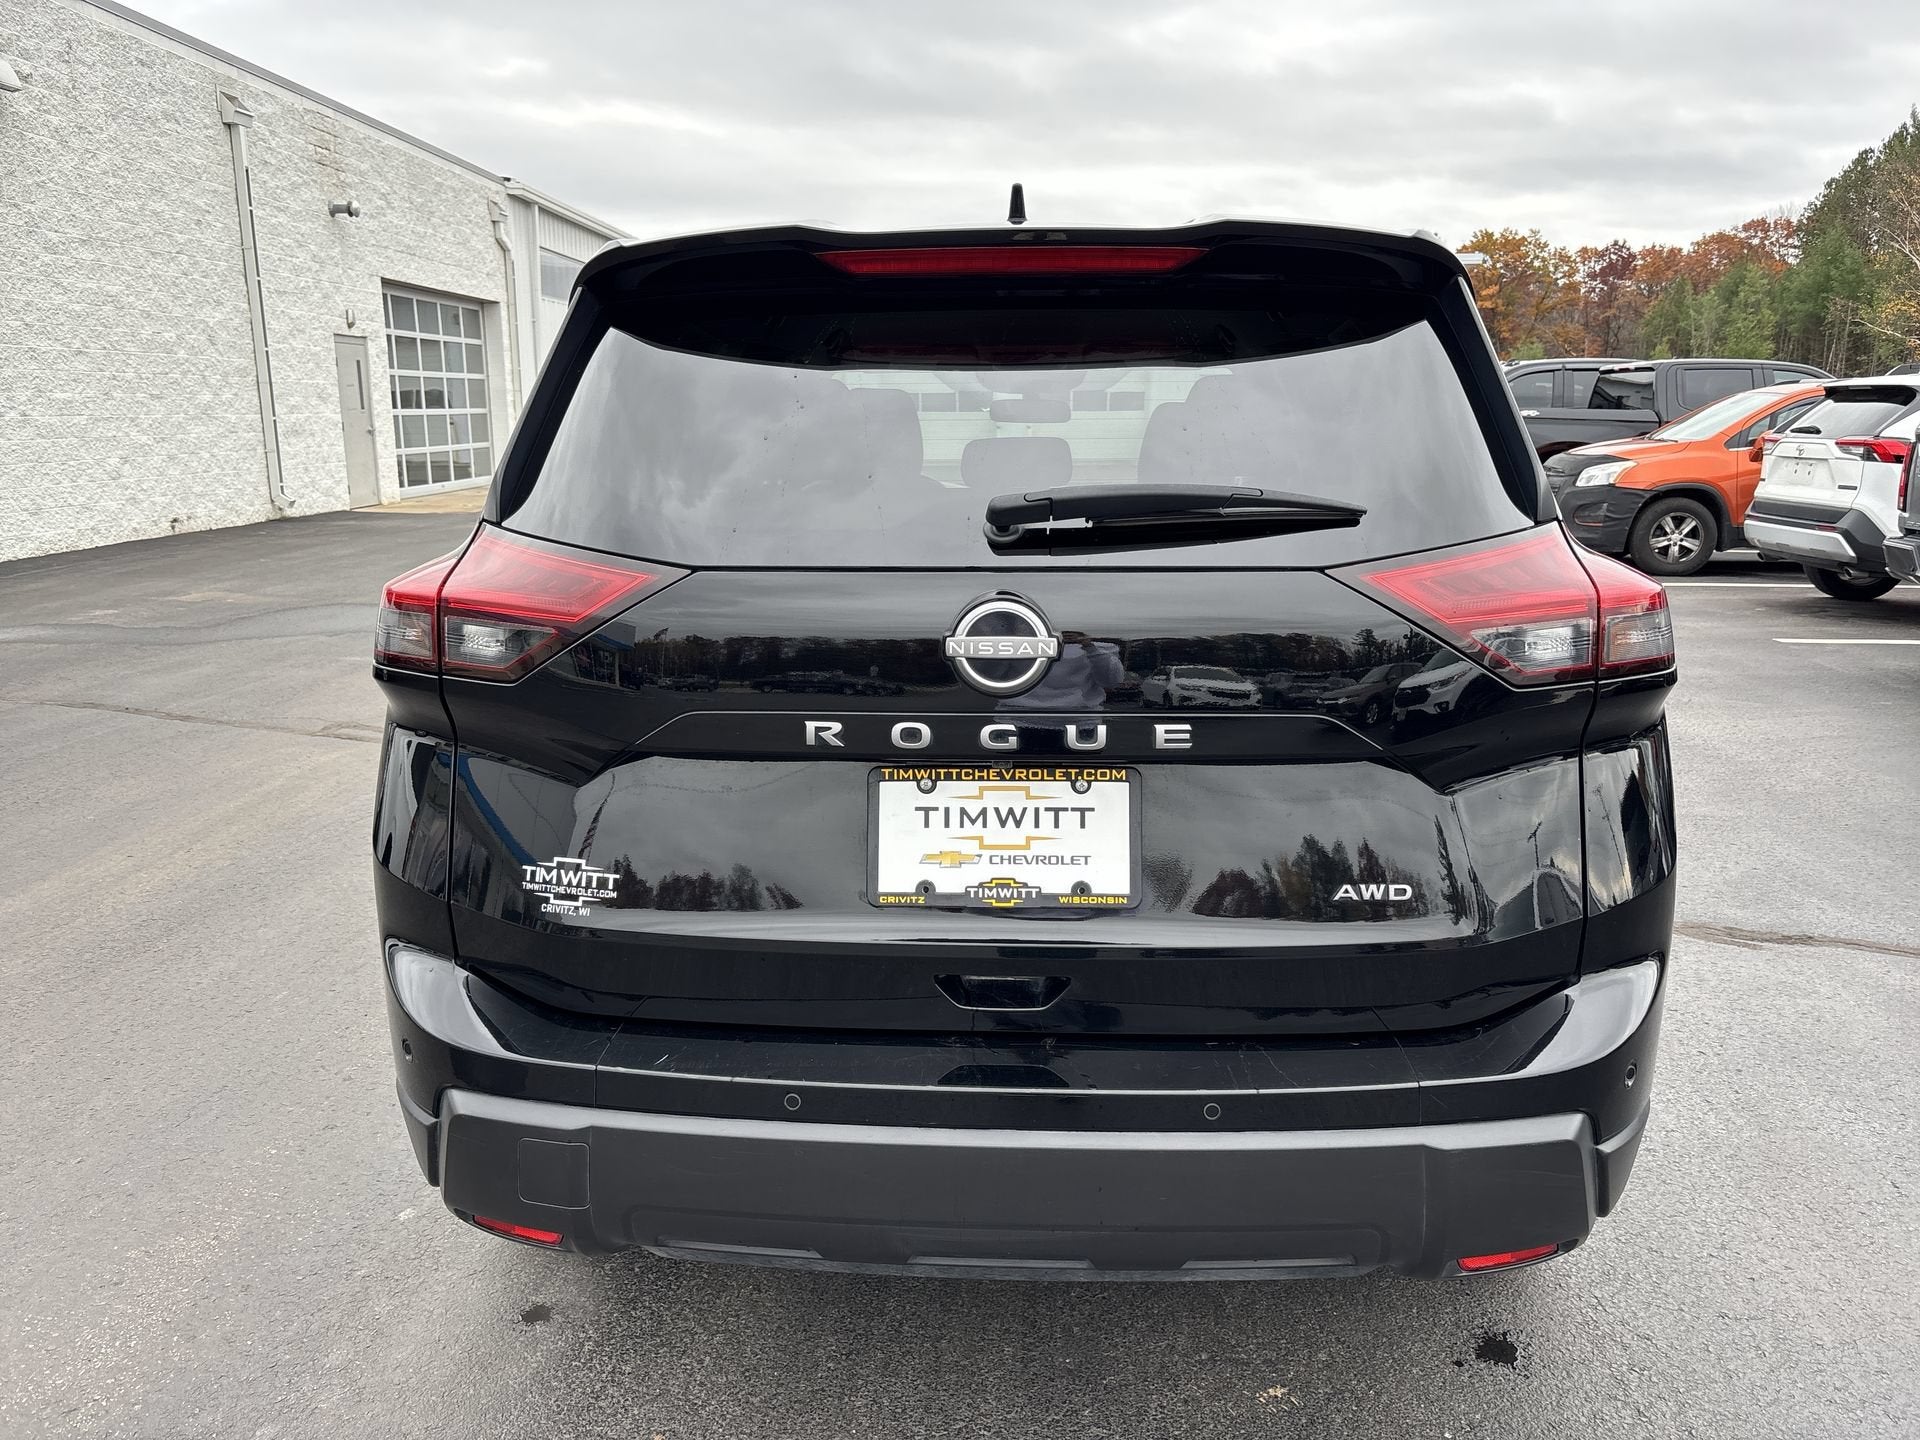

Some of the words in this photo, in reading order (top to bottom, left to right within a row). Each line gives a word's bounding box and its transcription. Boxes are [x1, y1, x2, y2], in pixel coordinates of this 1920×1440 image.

[948, 641, 1057, 655] NISSAN
[804, 720, 1193, 751] ROGUE
[881, 768, 1126, 781] TIMWITTCHEVROLET.COM
[914, 806, 1095, 829] TIMWITT
[988, 854, 1092, 866] CHEVROLET
[522, 865, 620, 889] TIMWITT
[522, 882, 617, 898] TIMWITTCHEVROLET.COM
[967, 886, 1040, 899] TIMWITT
[1332, 883, 1413, 901] AWD
[541, 903, 576, 916] CRIVITZ,
[579, 907, 590, 916] WI
